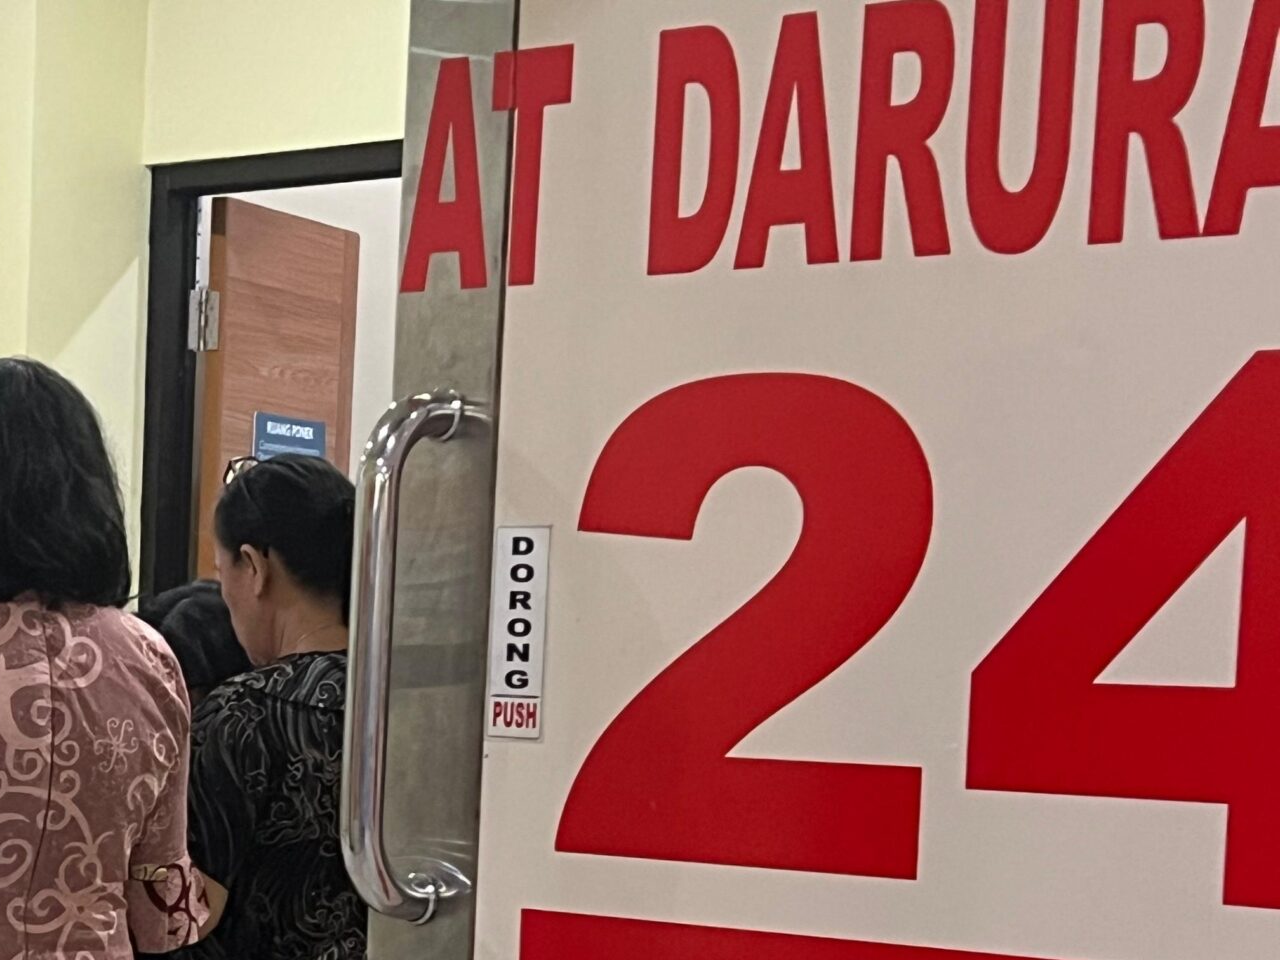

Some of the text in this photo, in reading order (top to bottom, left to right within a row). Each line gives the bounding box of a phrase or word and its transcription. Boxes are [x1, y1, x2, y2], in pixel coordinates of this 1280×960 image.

[400, 43, 576, 293] AT
[505, 537, 535, 689] DORONG
[555, 349, 1280, 910] 24
[492, 701, 538, 729] PUSH
